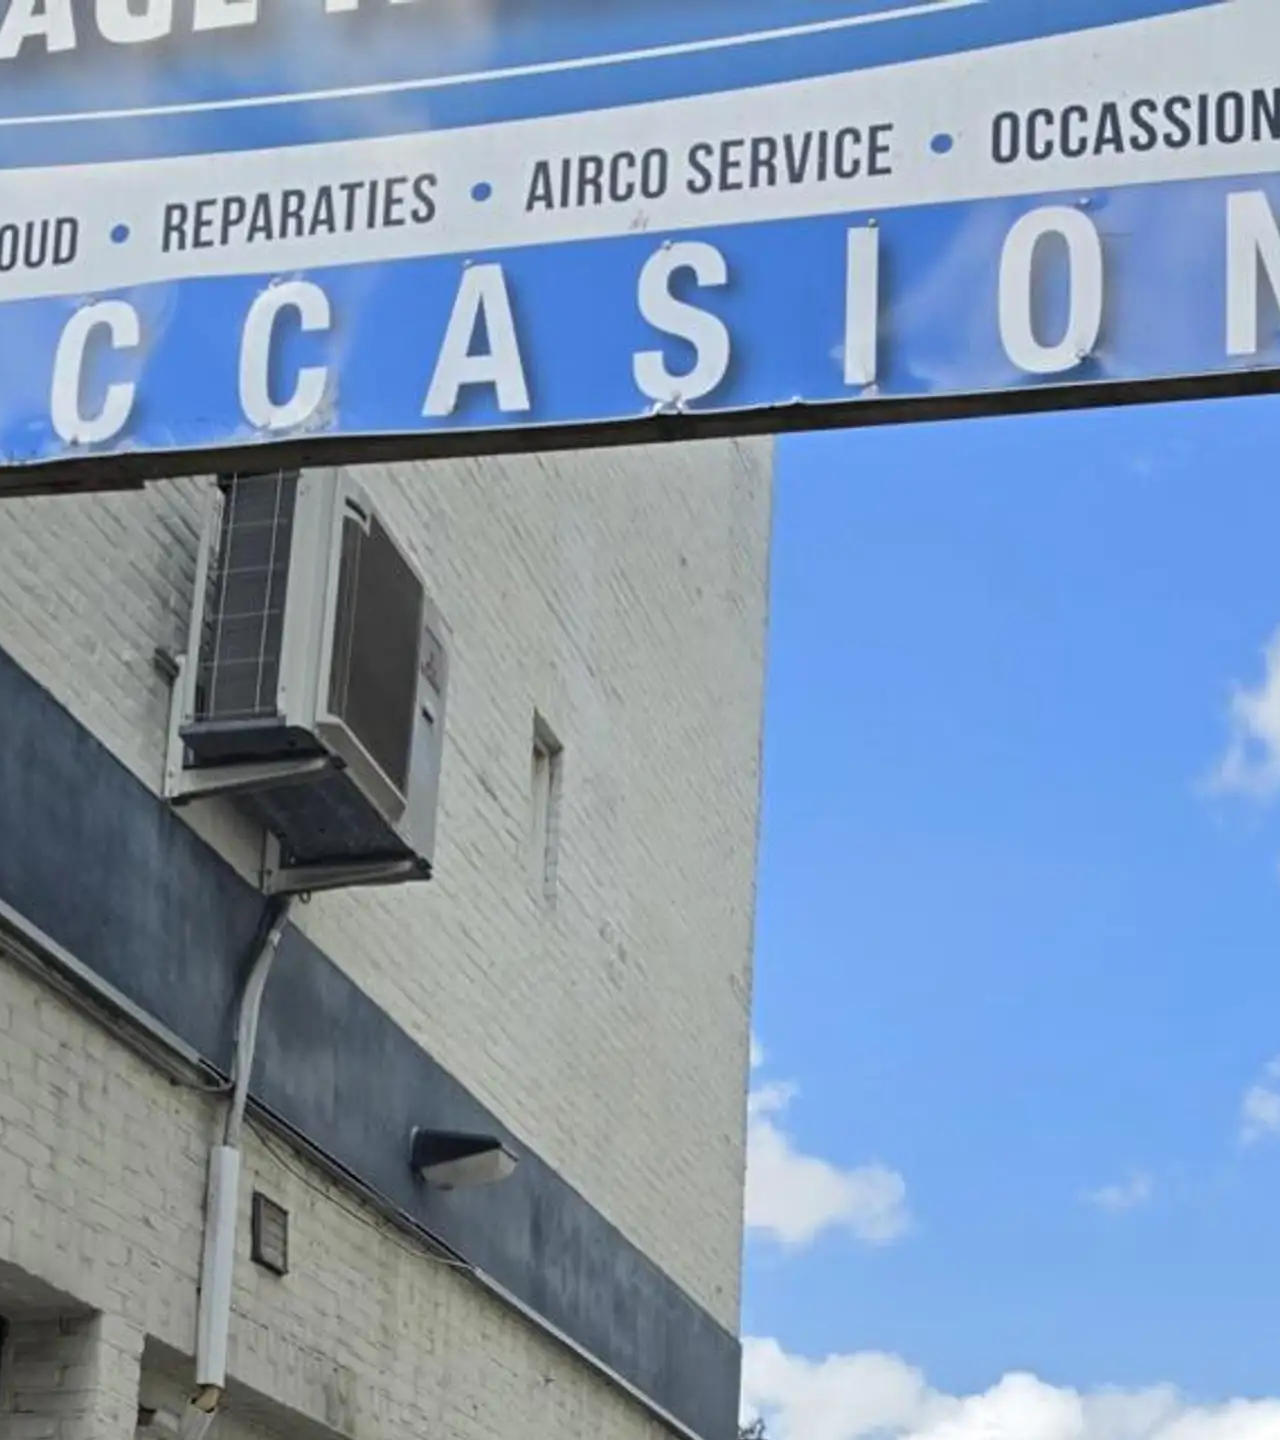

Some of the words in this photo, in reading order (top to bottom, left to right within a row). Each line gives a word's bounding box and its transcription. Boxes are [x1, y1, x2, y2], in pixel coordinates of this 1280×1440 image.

[162, 172, 438, 253] REPARATIES
[525, 147, 668, 212] AIRCO
[686, 122, 895, 195] SERVICE
